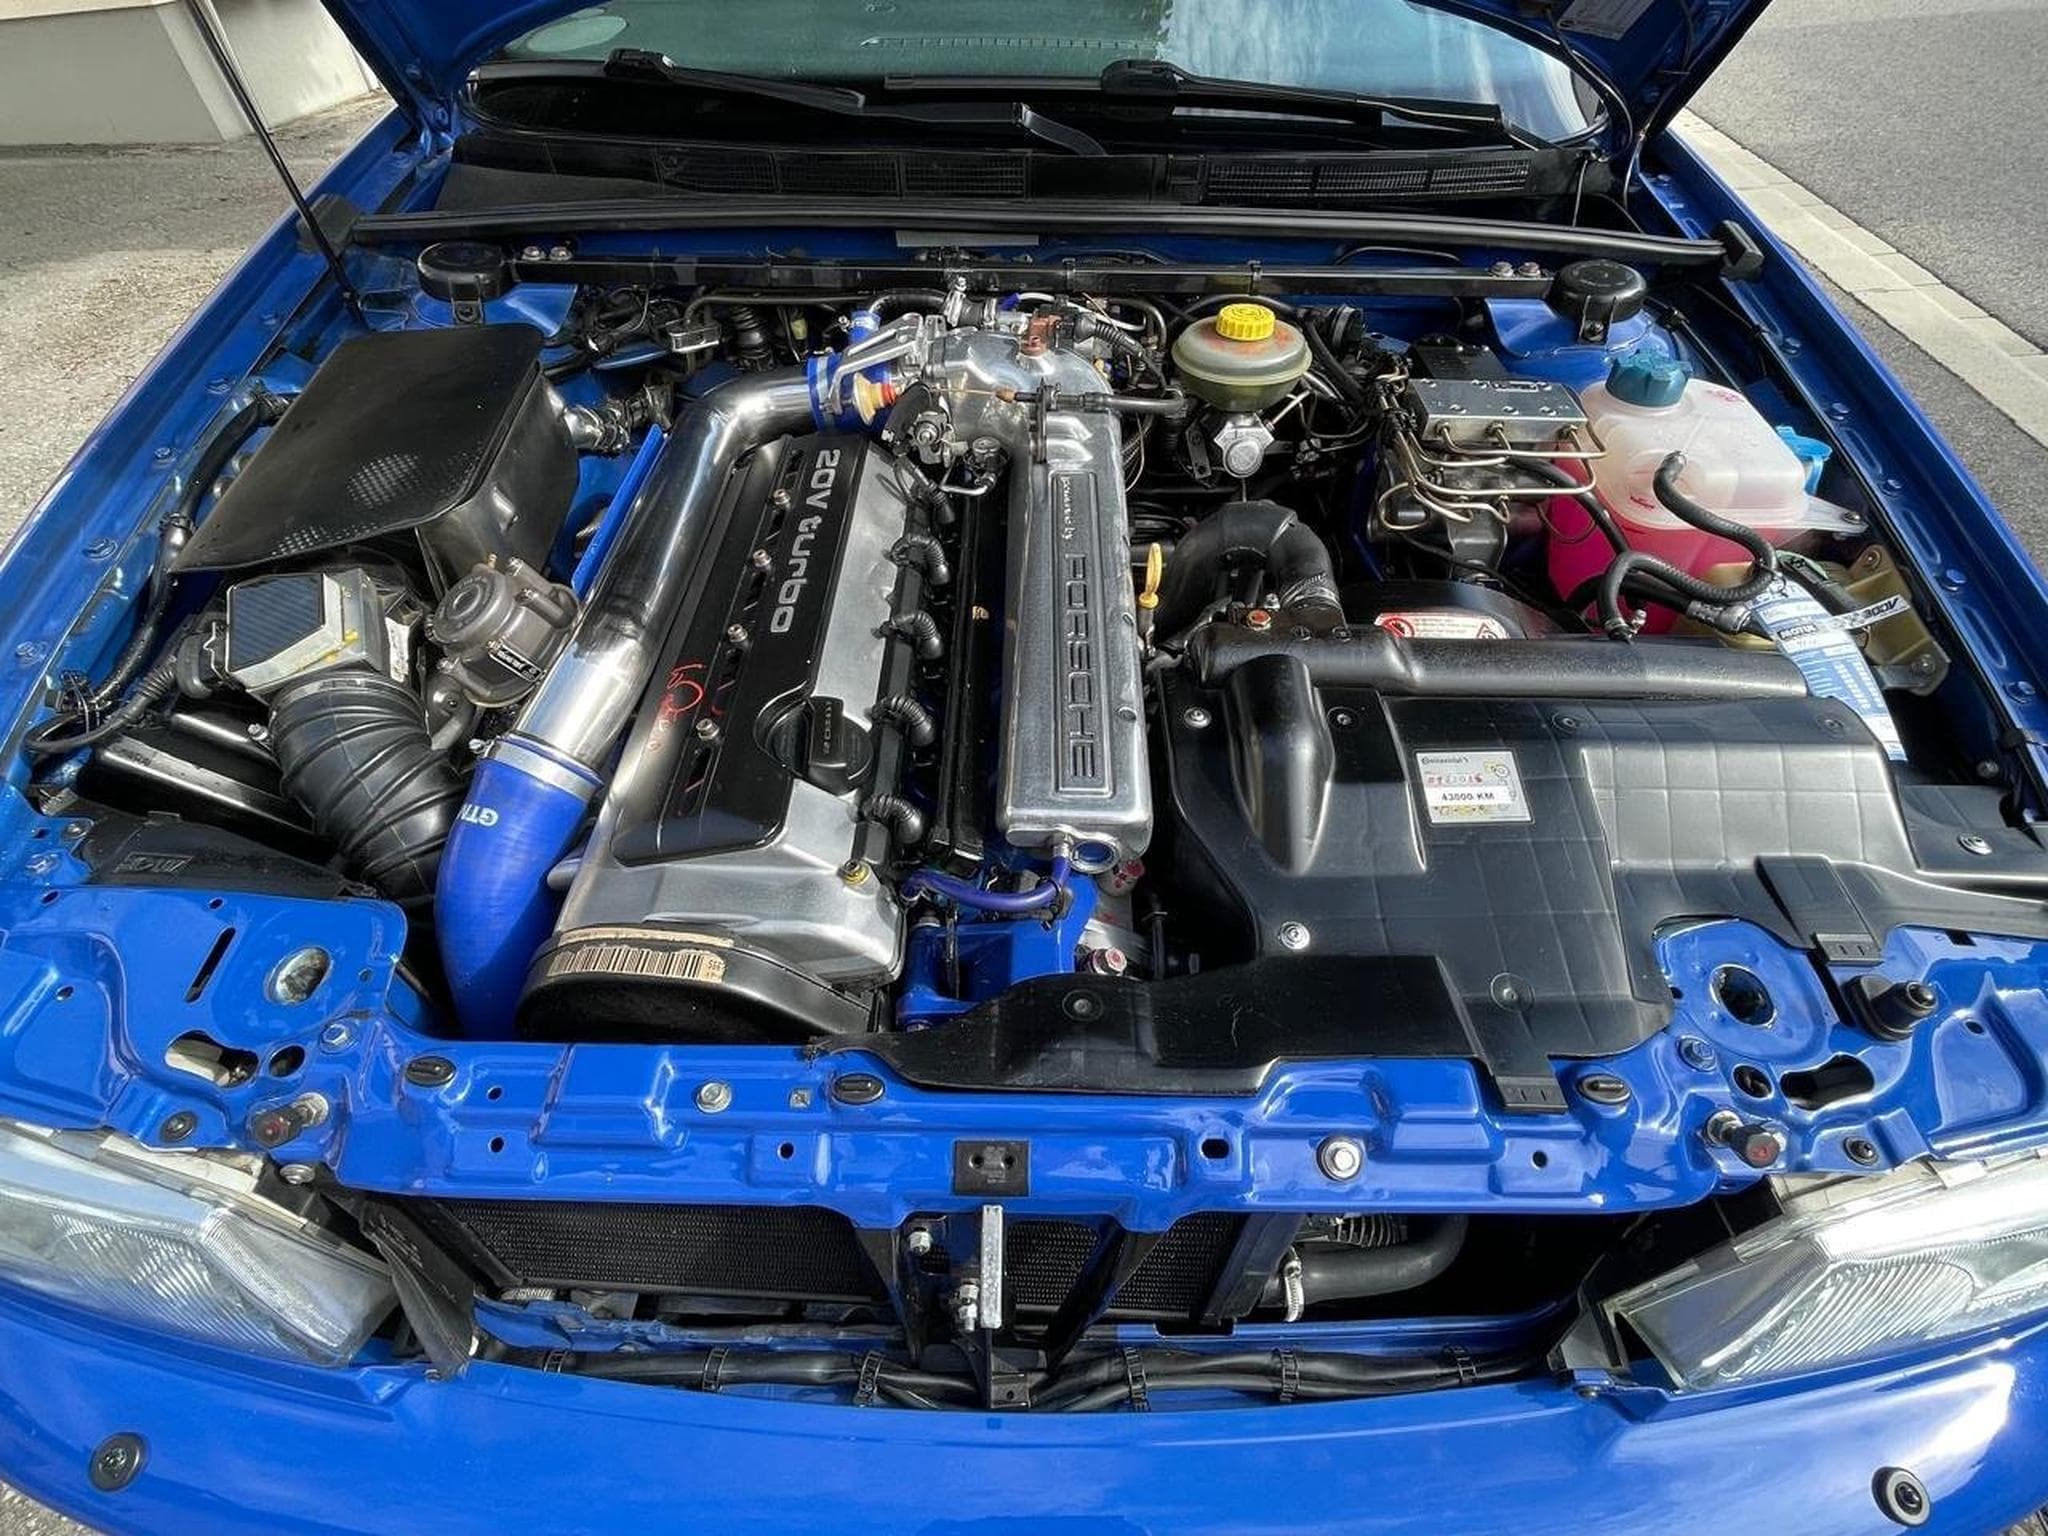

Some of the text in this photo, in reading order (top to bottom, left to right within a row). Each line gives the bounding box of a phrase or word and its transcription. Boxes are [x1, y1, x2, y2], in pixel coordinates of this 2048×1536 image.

[770, 449, 841, 633] 20V turbo
[1065, 553, 1095, 777] PORSCHE
